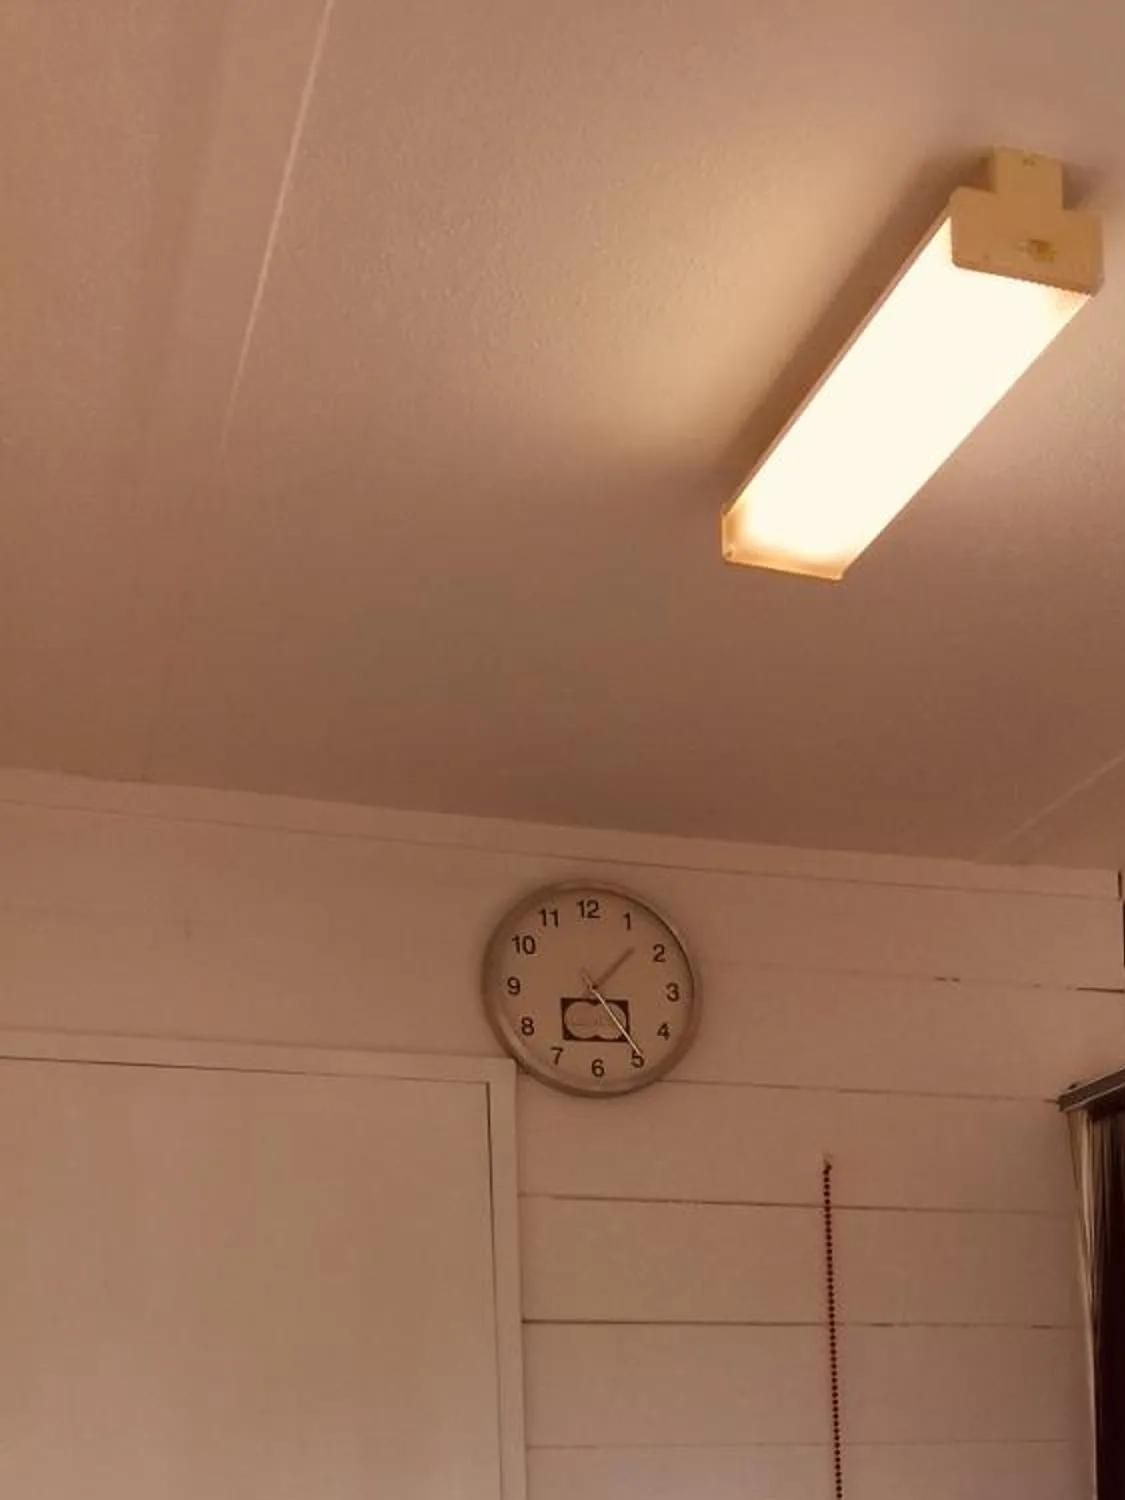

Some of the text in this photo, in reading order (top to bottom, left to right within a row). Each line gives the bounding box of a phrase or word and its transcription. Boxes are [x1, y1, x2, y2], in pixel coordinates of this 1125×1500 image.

[540, 909, 559, 928] 11
[577, 900, 600, 919] 12
[623, 912, 632, 931] 1
[512, 935, 536, 955] 10
[653, 944, 666, 962] 2
[507, 977, 521, 995] 9
[667, 983, 679, 1002] 3
[521, 1017, 535, 1036] 8
[657, 1022, 670, 1040] 4
[551, 1047, 564, 1065] 7
[631, 1051, 645, 1068] 5
[592, 1059, 605, 1077] 6
